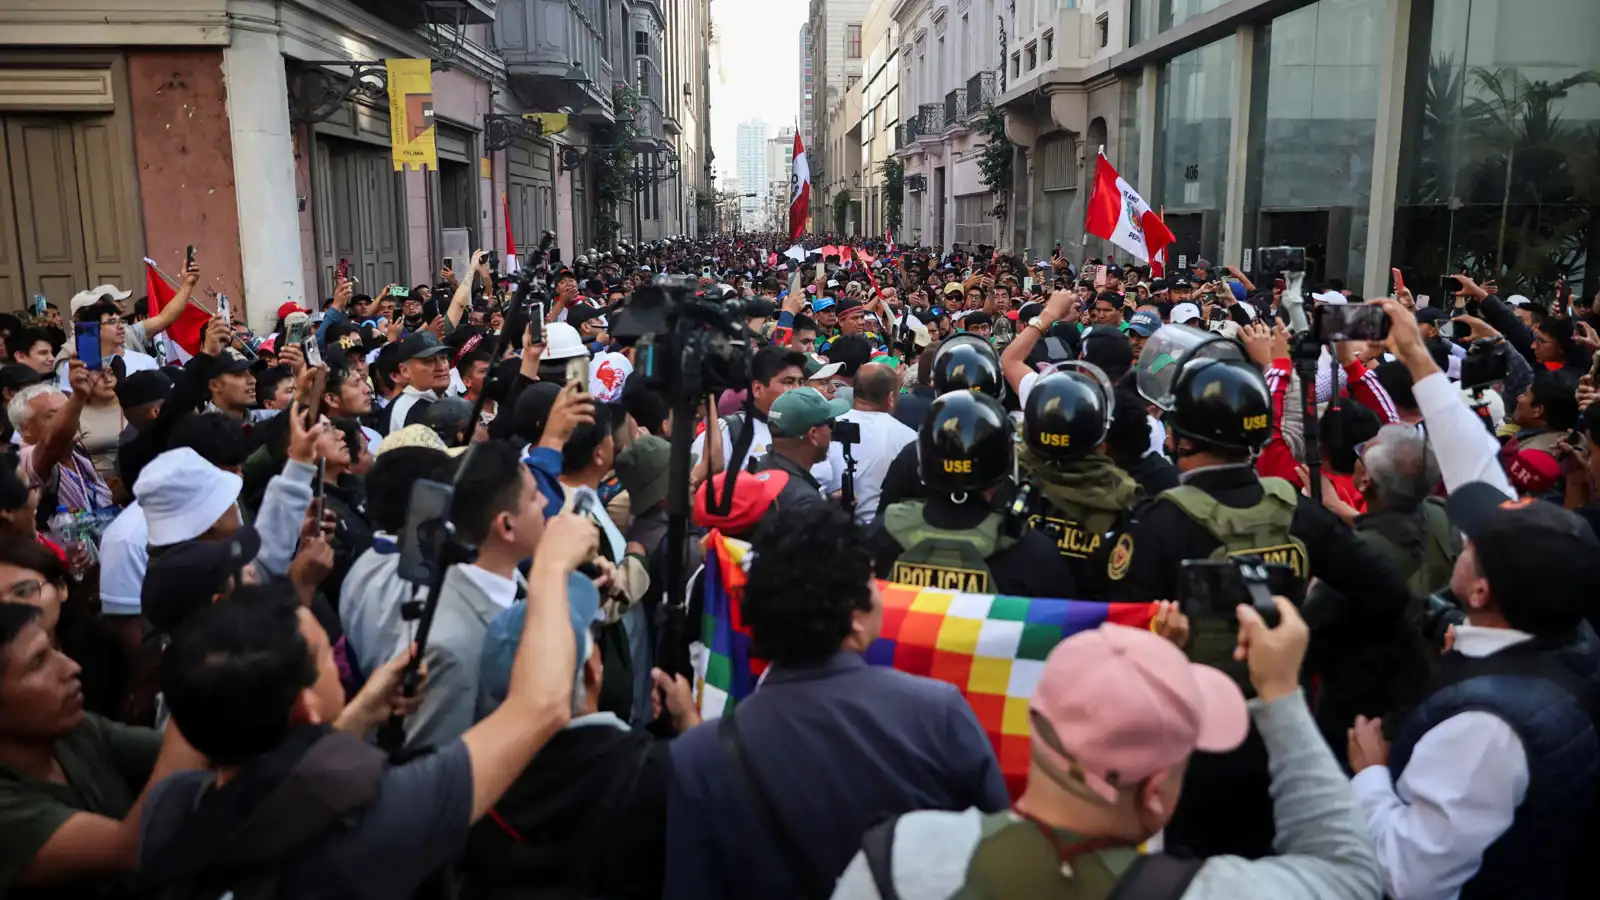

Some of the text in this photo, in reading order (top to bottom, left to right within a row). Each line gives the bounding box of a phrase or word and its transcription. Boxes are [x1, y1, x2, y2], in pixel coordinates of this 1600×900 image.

[1185, 164, 1198, 181] 406
[1128, 193, 1139, 203] AMO
[1243, 414, 1268, 431] USE
[1040, 432, 1070, 447] USE
[943, 459, 972, 473] USE
[899, 566, 979, 593] POLICIA
